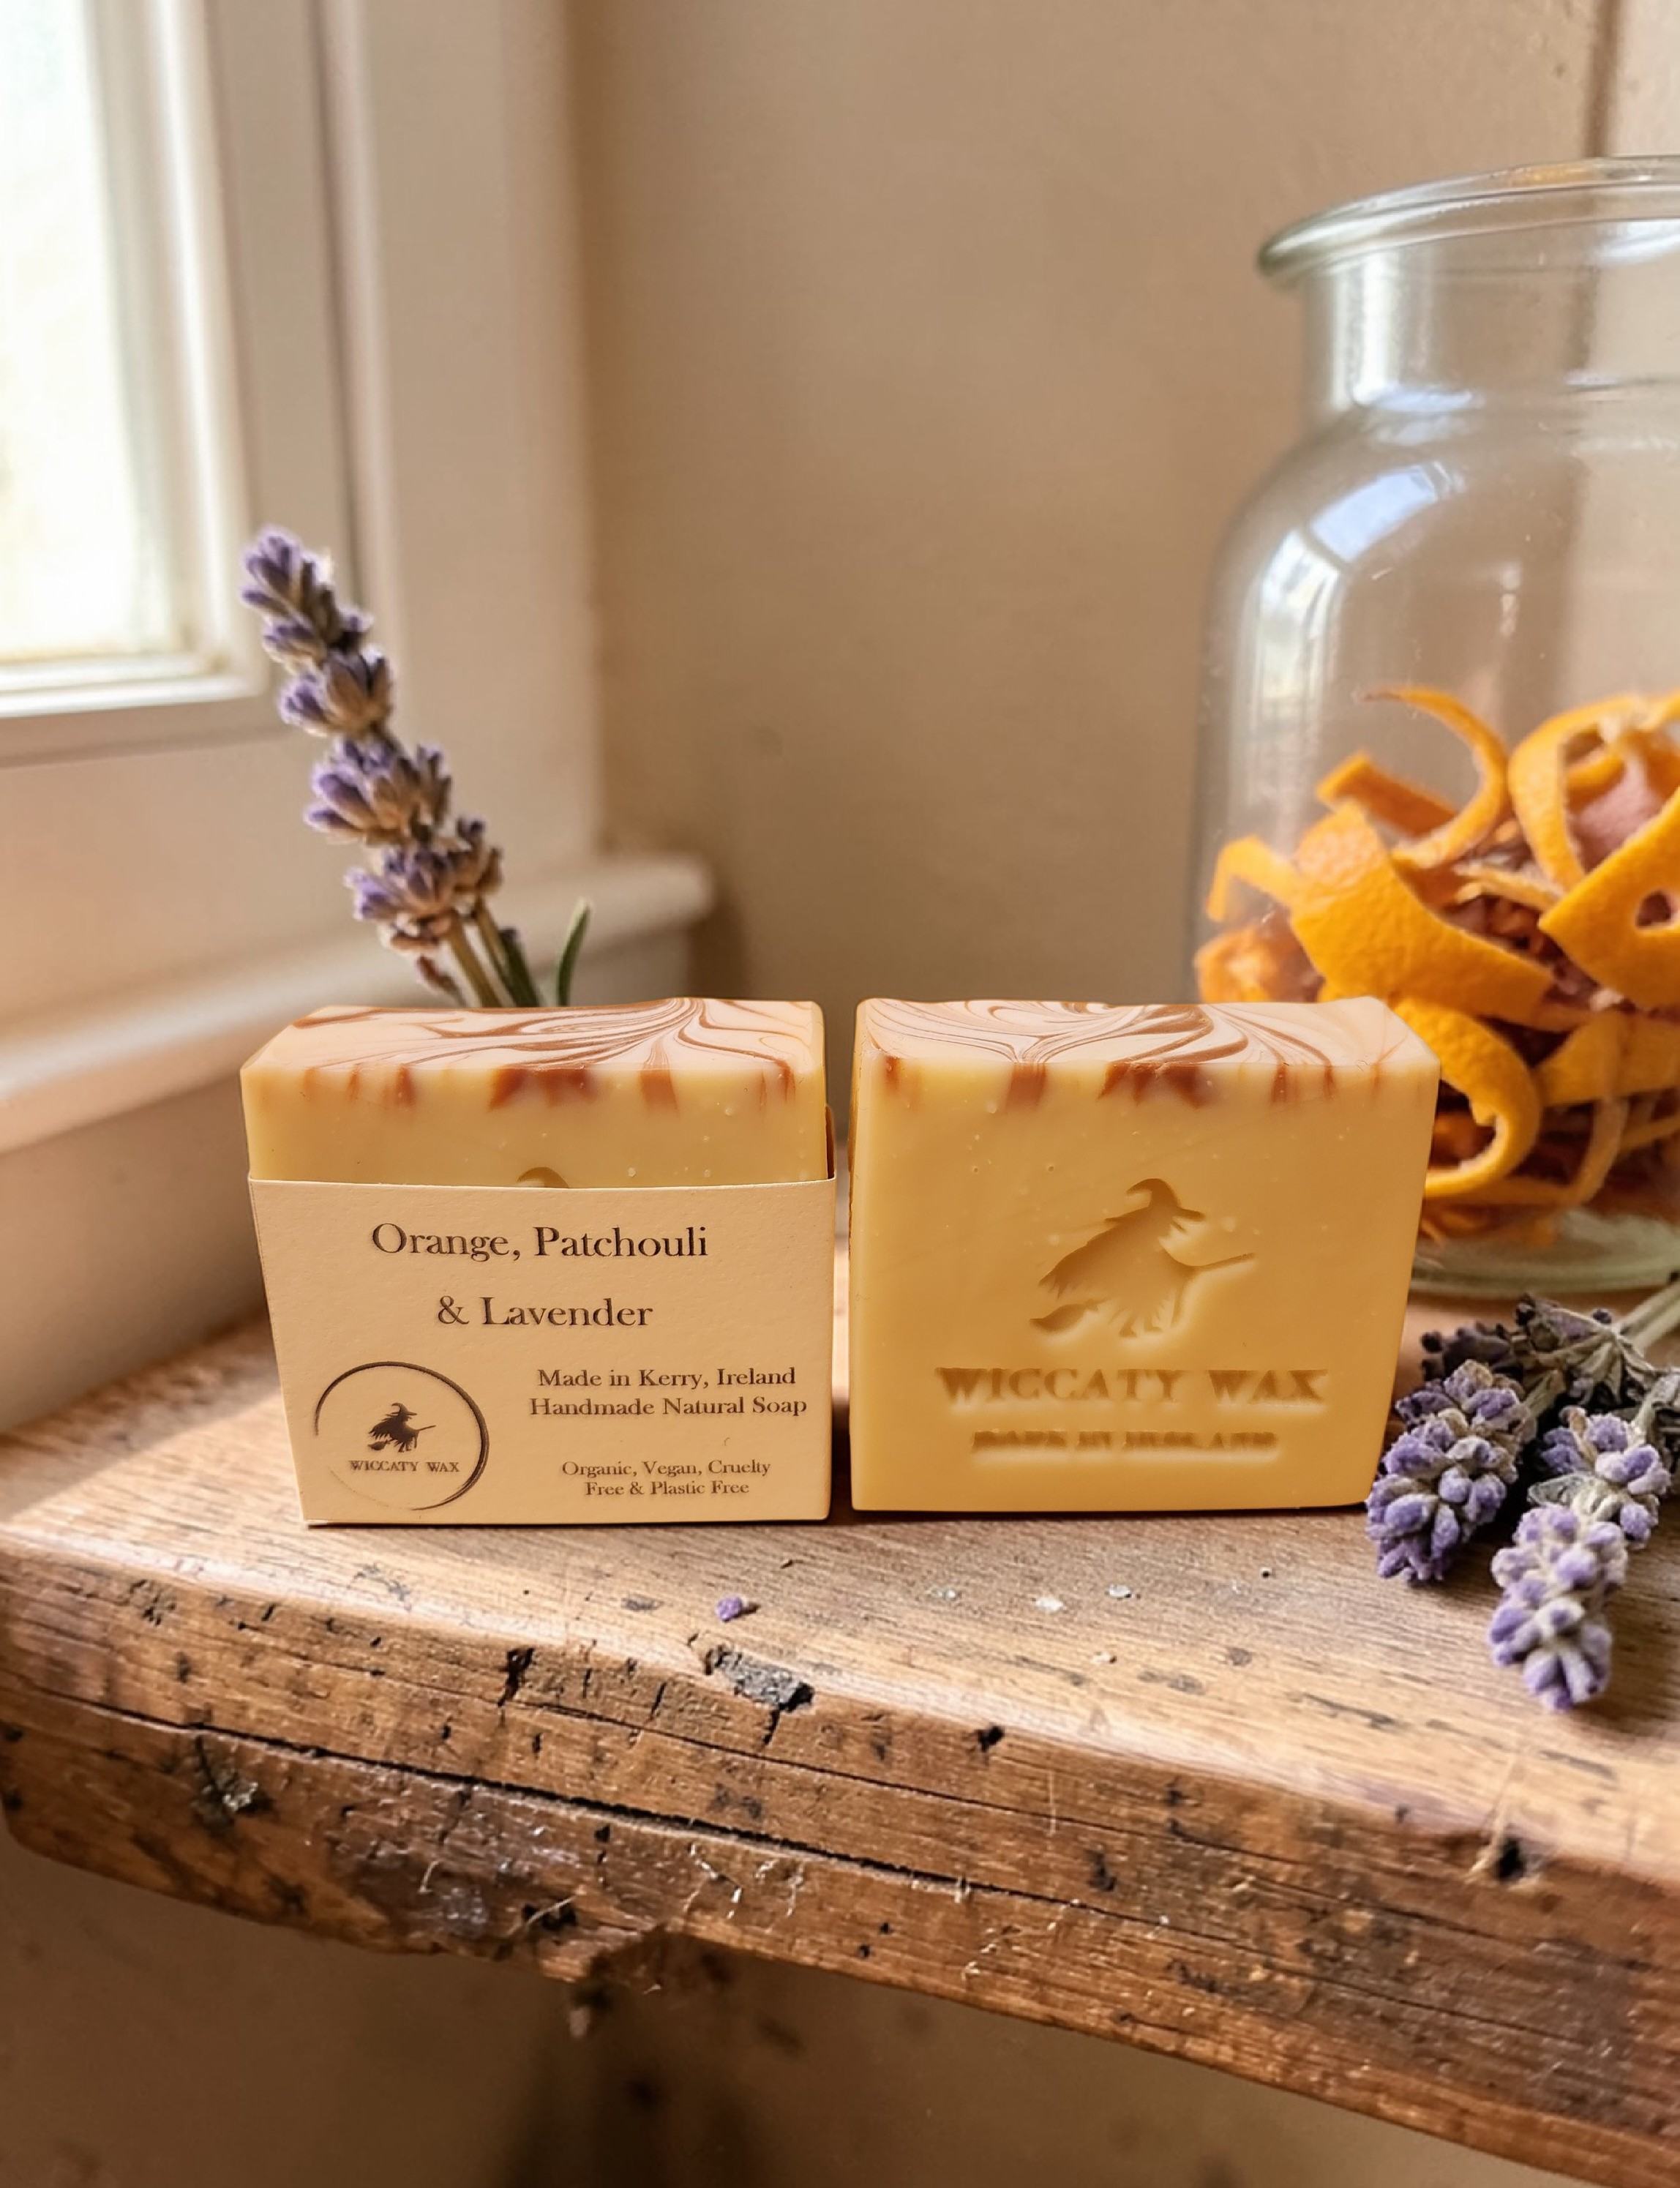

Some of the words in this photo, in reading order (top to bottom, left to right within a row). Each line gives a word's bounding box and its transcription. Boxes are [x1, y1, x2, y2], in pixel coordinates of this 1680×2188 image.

[371, 1223, 521, 1262] Orange,
[533, 1225, 708, 1257] Patchouli
[437, 1295, 470, 1326] &
[480, 1297, 654, 1327] Lavender
[537, 1369, 602, 1387] Made
[609, 1368, 632, 1387] in
[638, 1369, 710, 1390] Kerry,
[716, 1367, 797, 1387] Ireland
[935, 1367, 1189, 1405] WICCATY
[1206, 1368, 1328, 1406] WAX
[529, 1398, 655, 1417] Handmade
[662, 1397, 745, 1415] Natural
[752, 1395, 807, 1417] Soap
[349, 1460, 419, 1472] WICCATY
[426, 1461, 460, 1473] WAX
[562, 1461, 637, 1479] Organic,
[642, 1461, 702, 1478] Vegan,
[708, 1458, 771, 1477] Cruelty
[585, 1481, 625, 1496] Free
[629, 1481, 645, 1496] &
[650, 1480, 706, 1496] Plastic
[710, 1480, 750, 1495] Free
